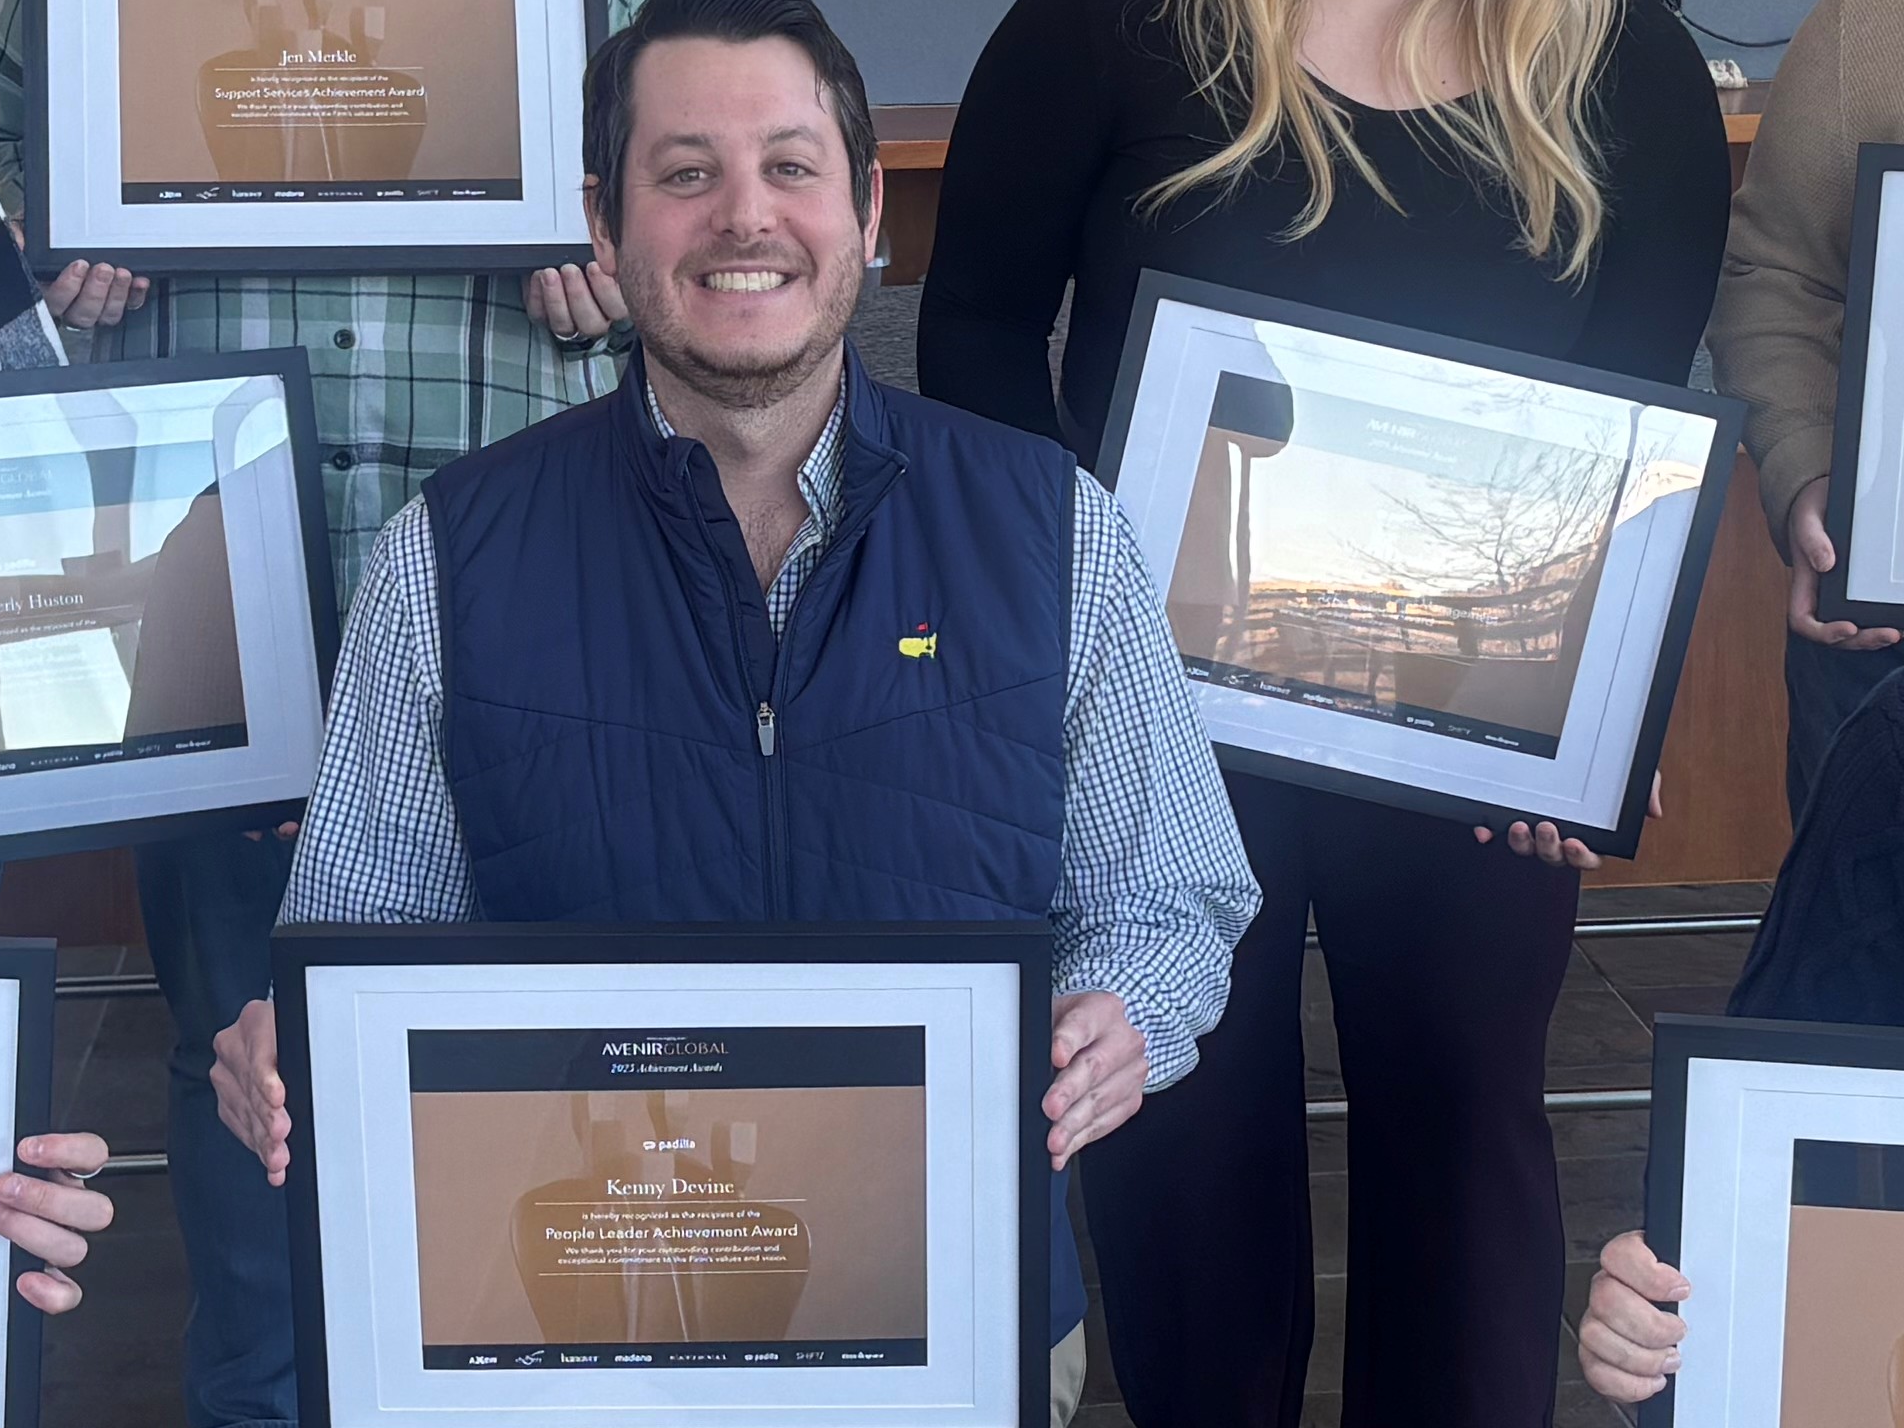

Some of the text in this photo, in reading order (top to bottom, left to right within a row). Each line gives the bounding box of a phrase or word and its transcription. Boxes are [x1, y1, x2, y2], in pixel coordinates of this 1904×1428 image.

[278, 48, 357, 66] Jen Merkle
[214, 85, 425, 100] Support Services Achievement Award
[28, 593, 84, 609] Huston
[607, 1177, 734, 1200] Kenny Devine
[545, 1223, 798, 1243] People Leader Achievement Award
